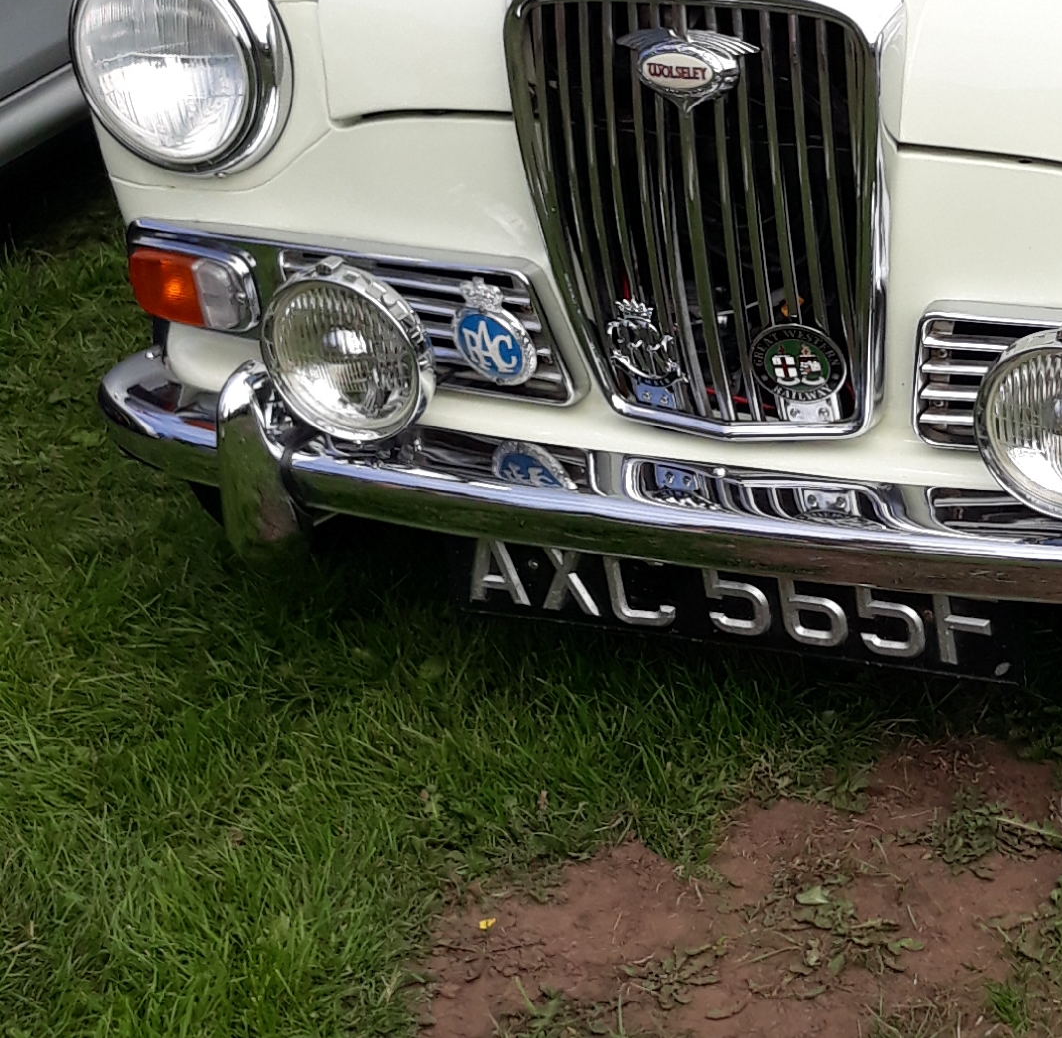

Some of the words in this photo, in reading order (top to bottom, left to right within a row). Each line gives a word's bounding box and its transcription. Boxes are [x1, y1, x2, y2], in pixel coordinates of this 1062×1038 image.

[647, 62, 707, 81] WOLSELEY
[462, 320, 518, 374] RAC
[753, 331, 779, 367] GREAT
[783, 328, 841, 367] WESTERN
[773, 383, 832, 401] RAILWAY
[470, 539, 677, 627] AXC
[702, 568, 992, 665] 565F
